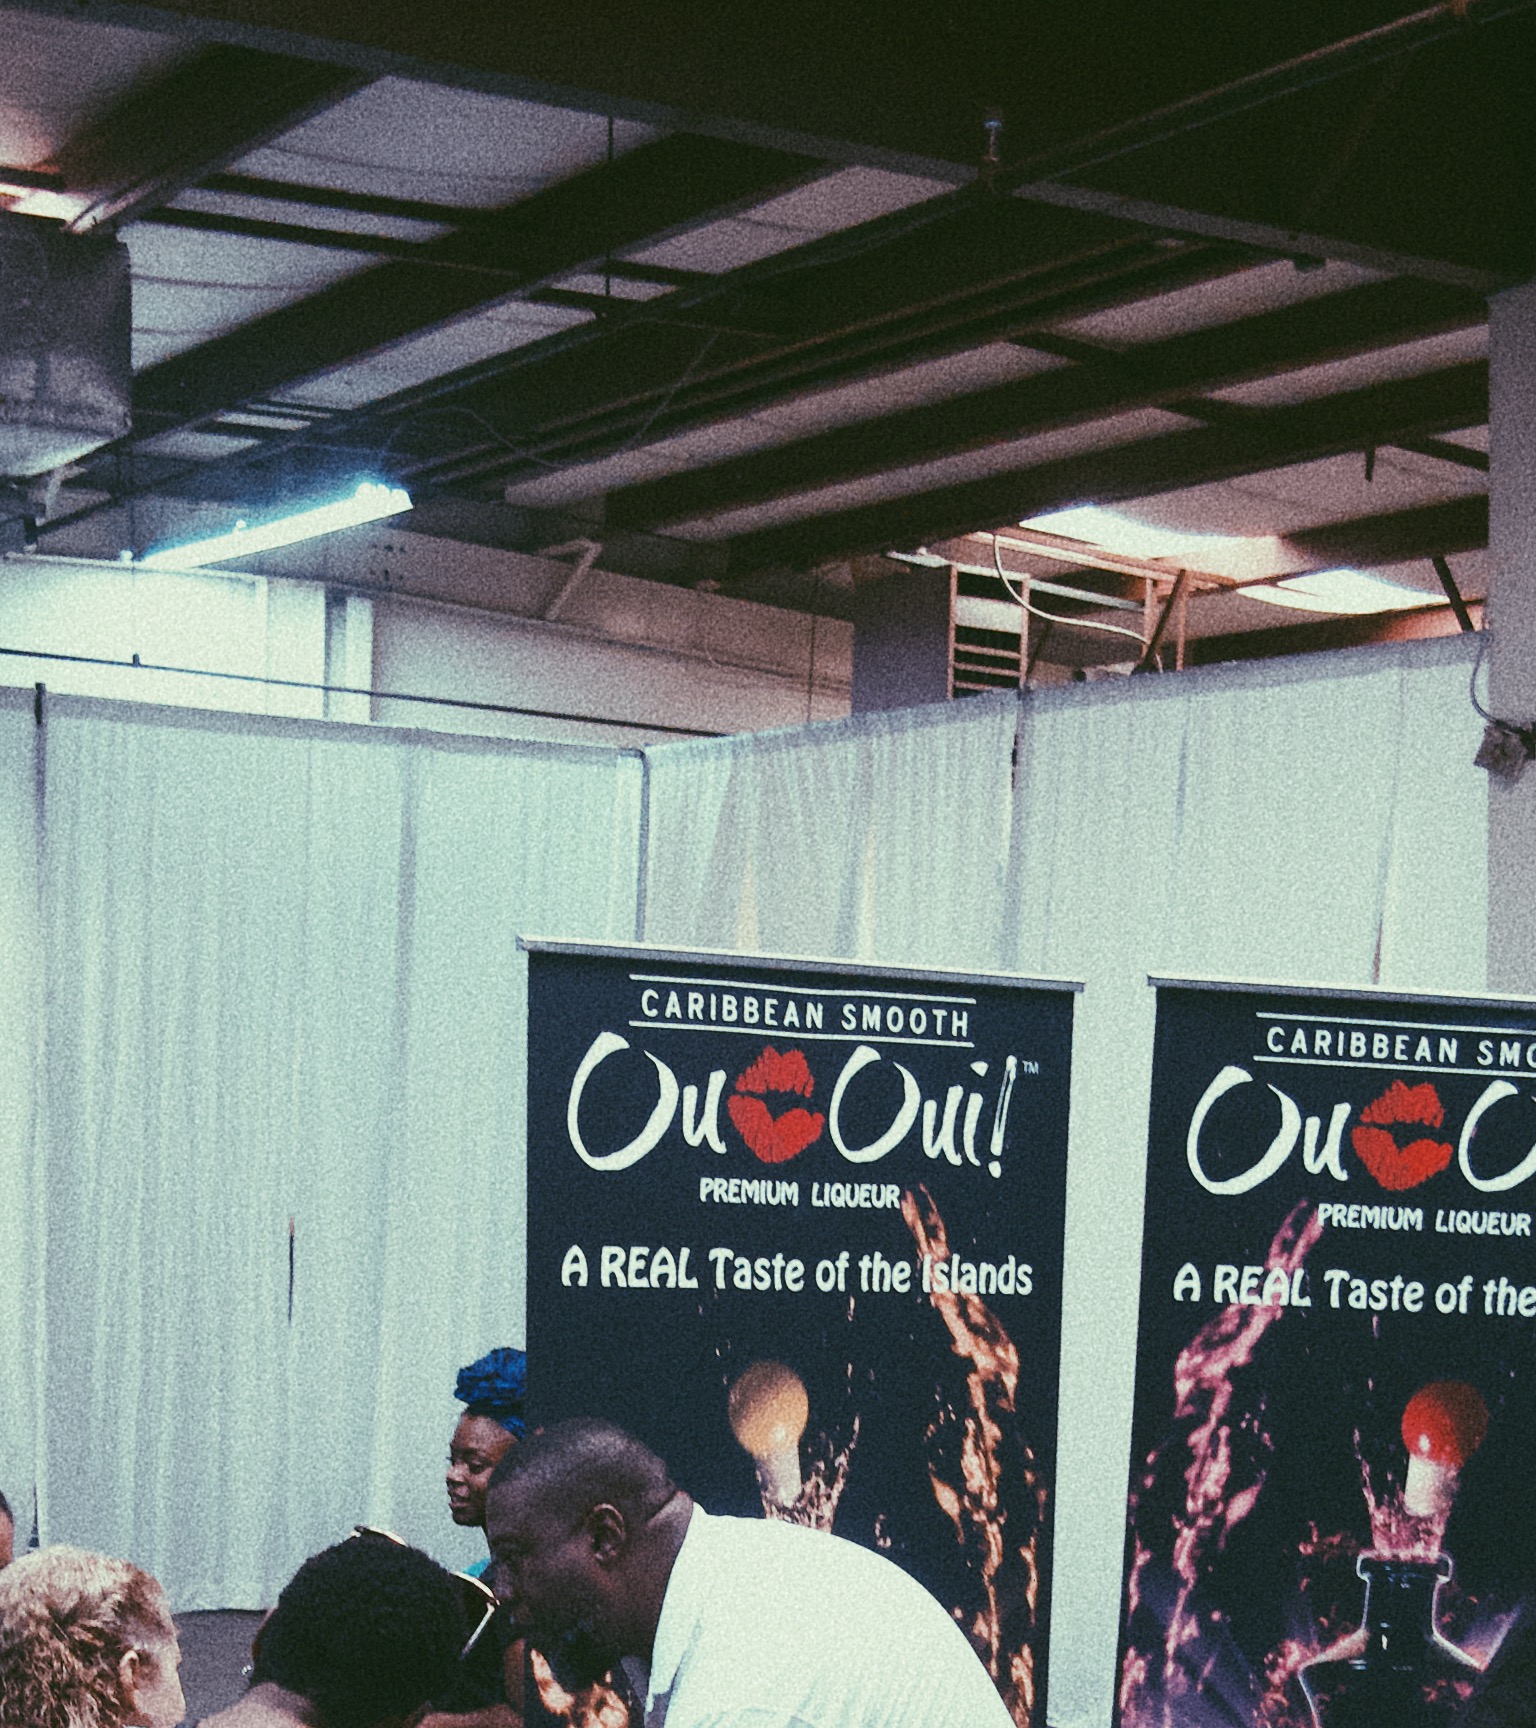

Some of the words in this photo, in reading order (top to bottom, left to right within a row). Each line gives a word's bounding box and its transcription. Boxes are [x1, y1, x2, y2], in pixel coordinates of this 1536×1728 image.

[640, 986, 825, 1031] CARIBBEAN
[840, 1002, 970, 1039] SMOOTH
[1265, 1025, 1459, 1065] CARIBBEAN
[567, 1030, 728, 1172] Ou
[1186, 1064, 1352, 1196] Ou
[699, 1176, 799, 1206] PREMIUM
[811, 1181, 902, 1209] LIQUEUR
[1317, 1202, 1423, 1231] PREMIUM
[1435, 1208, 1532, 1237] LIQUEUR
[560, 1244, 589, 1287] A
[600, 1245, 699, 1289] REAL
[707, 1247, 805, 1293] Taste
[815, 1250, 850, 1293] of
[859, 1250, 911, 1293] the
[922, 1252, 1033, 1296] Islands
[1172, 1262, 1201, 1302] A
[1214, 1264, 1311, 1307] REAL
[1323, 1267, 1425, 1314] Taste
[1435, 1272, 1473, 1315] of
